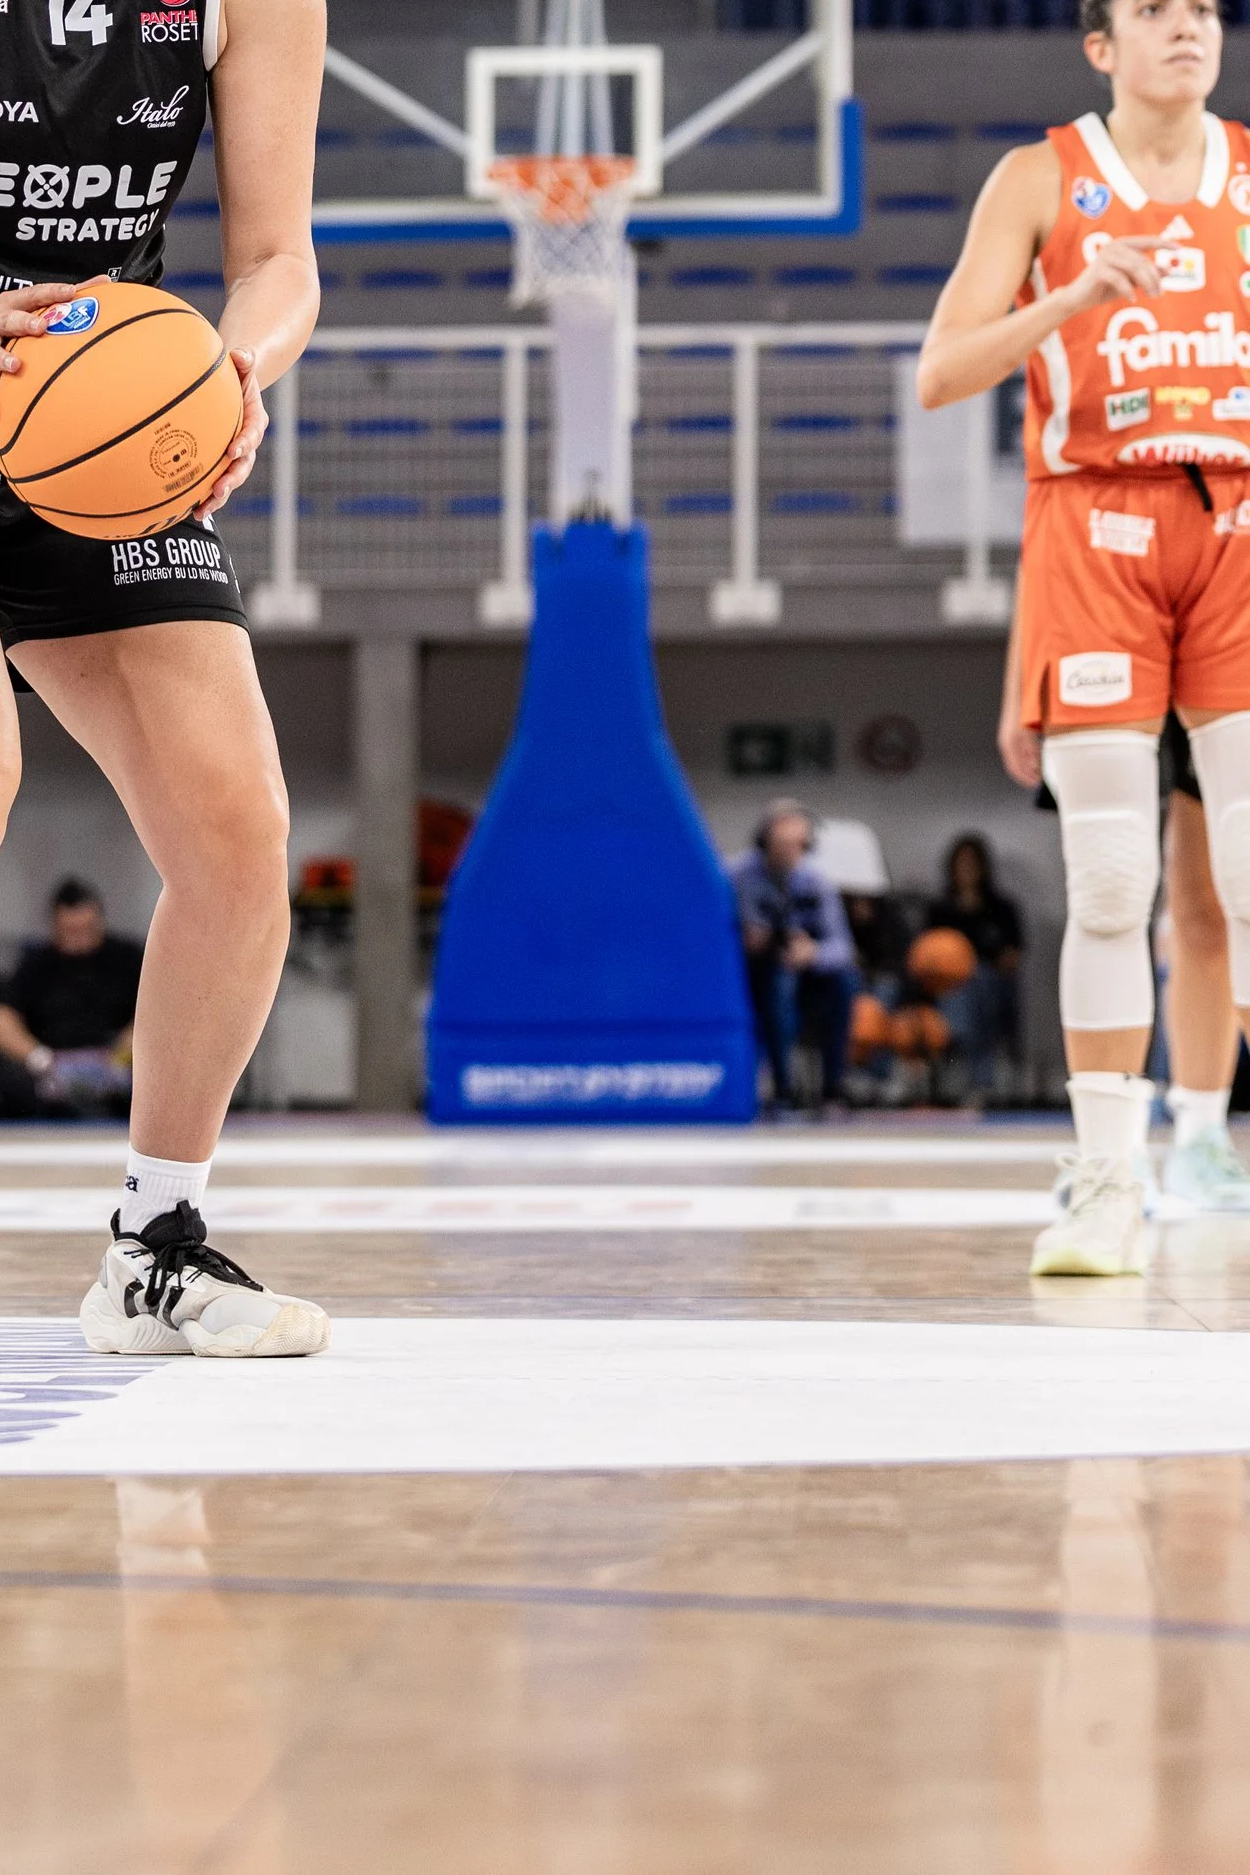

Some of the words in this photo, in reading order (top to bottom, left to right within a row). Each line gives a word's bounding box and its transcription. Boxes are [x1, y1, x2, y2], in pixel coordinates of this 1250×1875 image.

[140, 9, 198, 26] PANTH
[141, 22, 199, 43] ROSET
[116, 85, 190, 125] Italo
[15, 208, 161, 242] STRATEGY
[111, 538, 160, 572] HBS
[165, 537, 221, 569] GROUP
[114, 570, 140, 586] GREEN
[141, 567, 173, 582] ENERGY
[210, 569, 229, 585] WOOD
